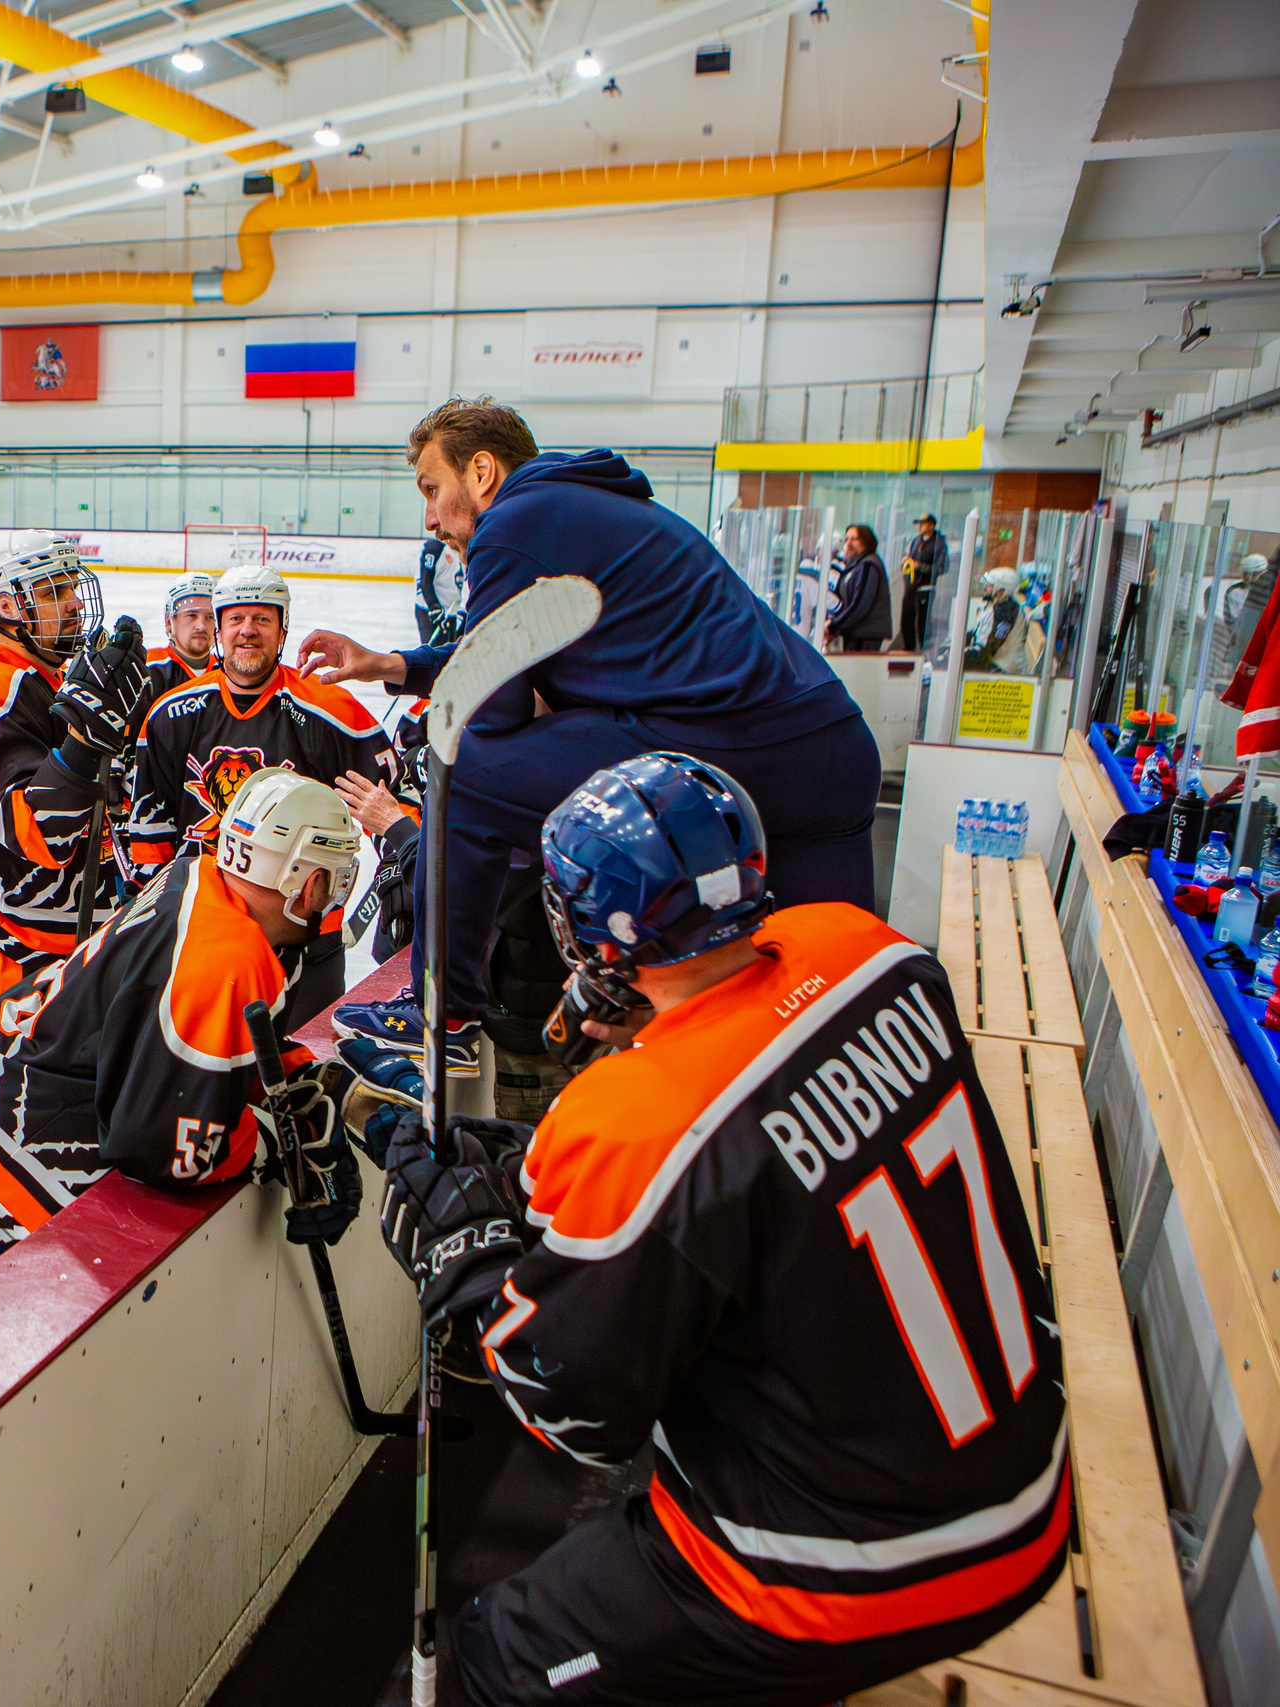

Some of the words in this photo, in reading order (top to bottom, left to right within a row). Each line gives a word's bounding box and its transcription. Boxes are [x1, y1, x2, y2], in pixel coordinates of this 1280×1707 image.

[374, 748, 399, 786] 7
[223, 834, 253, 875] 55
[774, 974, 827, 1019] LUTCH
[760, 982, 953, 1193] BUBNOV
[835, 1079, 1038, 1450] 17
[546, 1651, 601, 1689] WARRIOR
